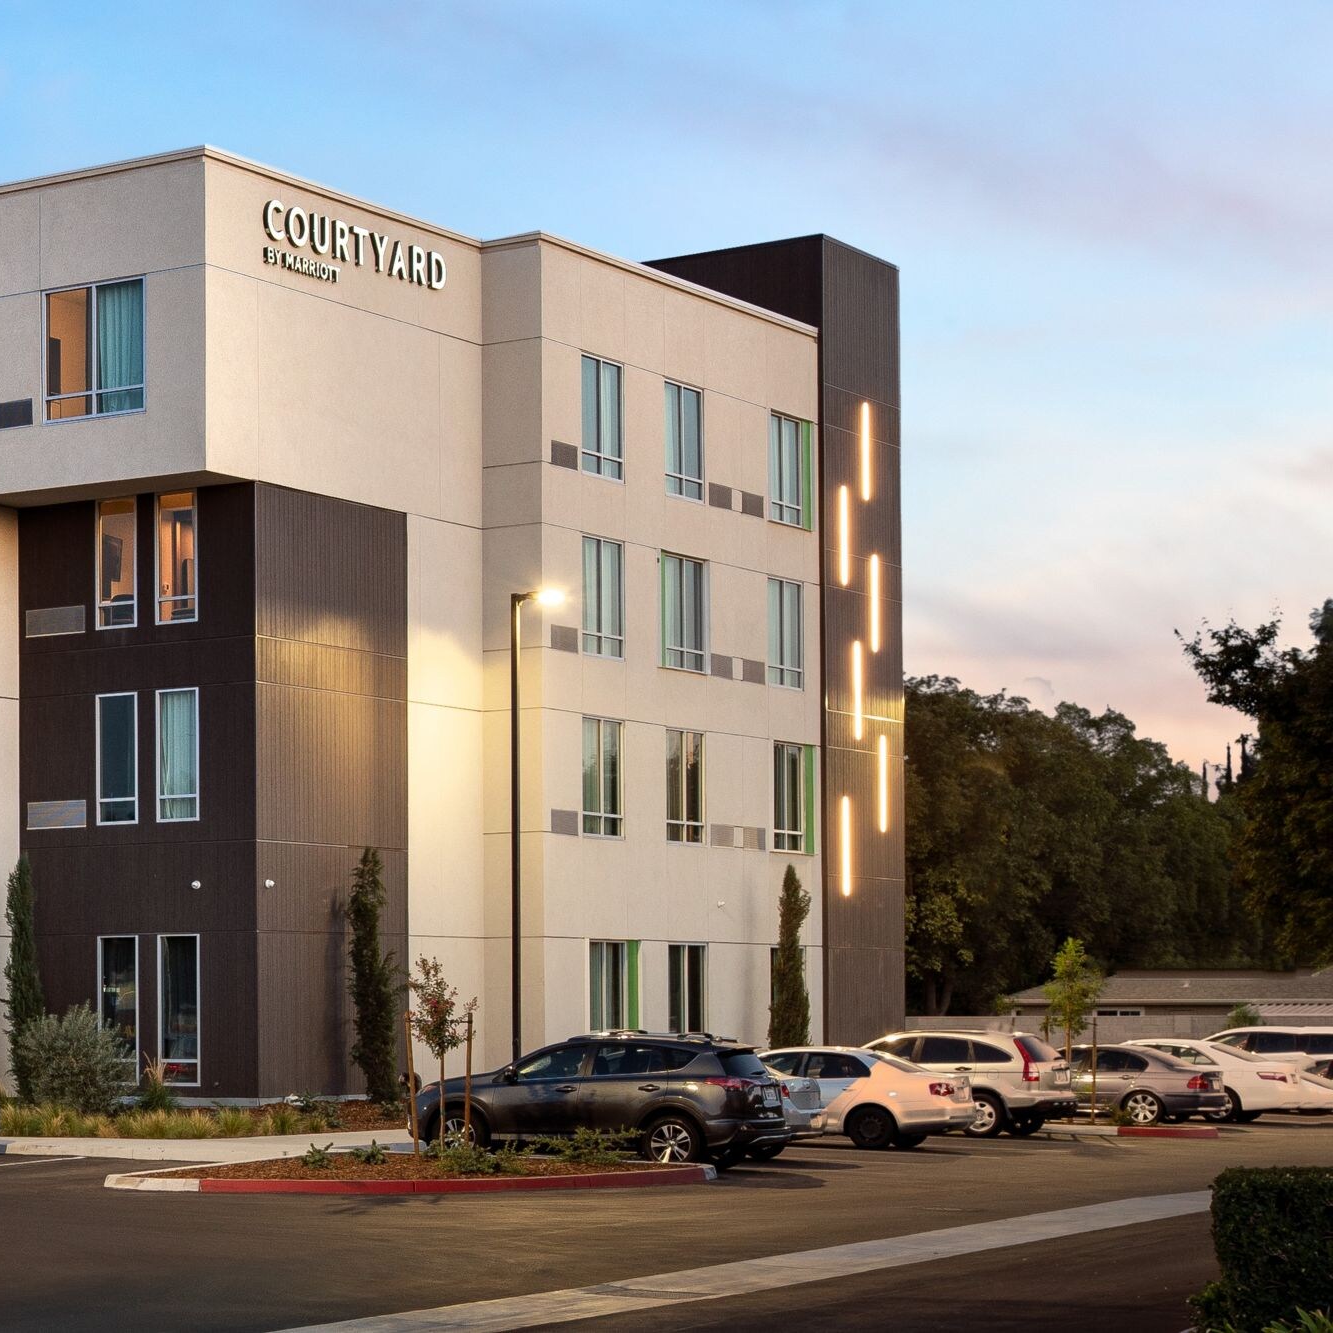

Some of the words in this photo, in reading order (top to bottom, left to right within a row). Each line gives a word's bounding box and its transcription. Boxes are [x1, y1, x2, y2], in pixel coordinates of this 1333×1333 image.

[263, 199, 447, 290] COURTYARD
[263, 246, 282, 265] BY
[282, 251, 341, 283] MARRIOTT
